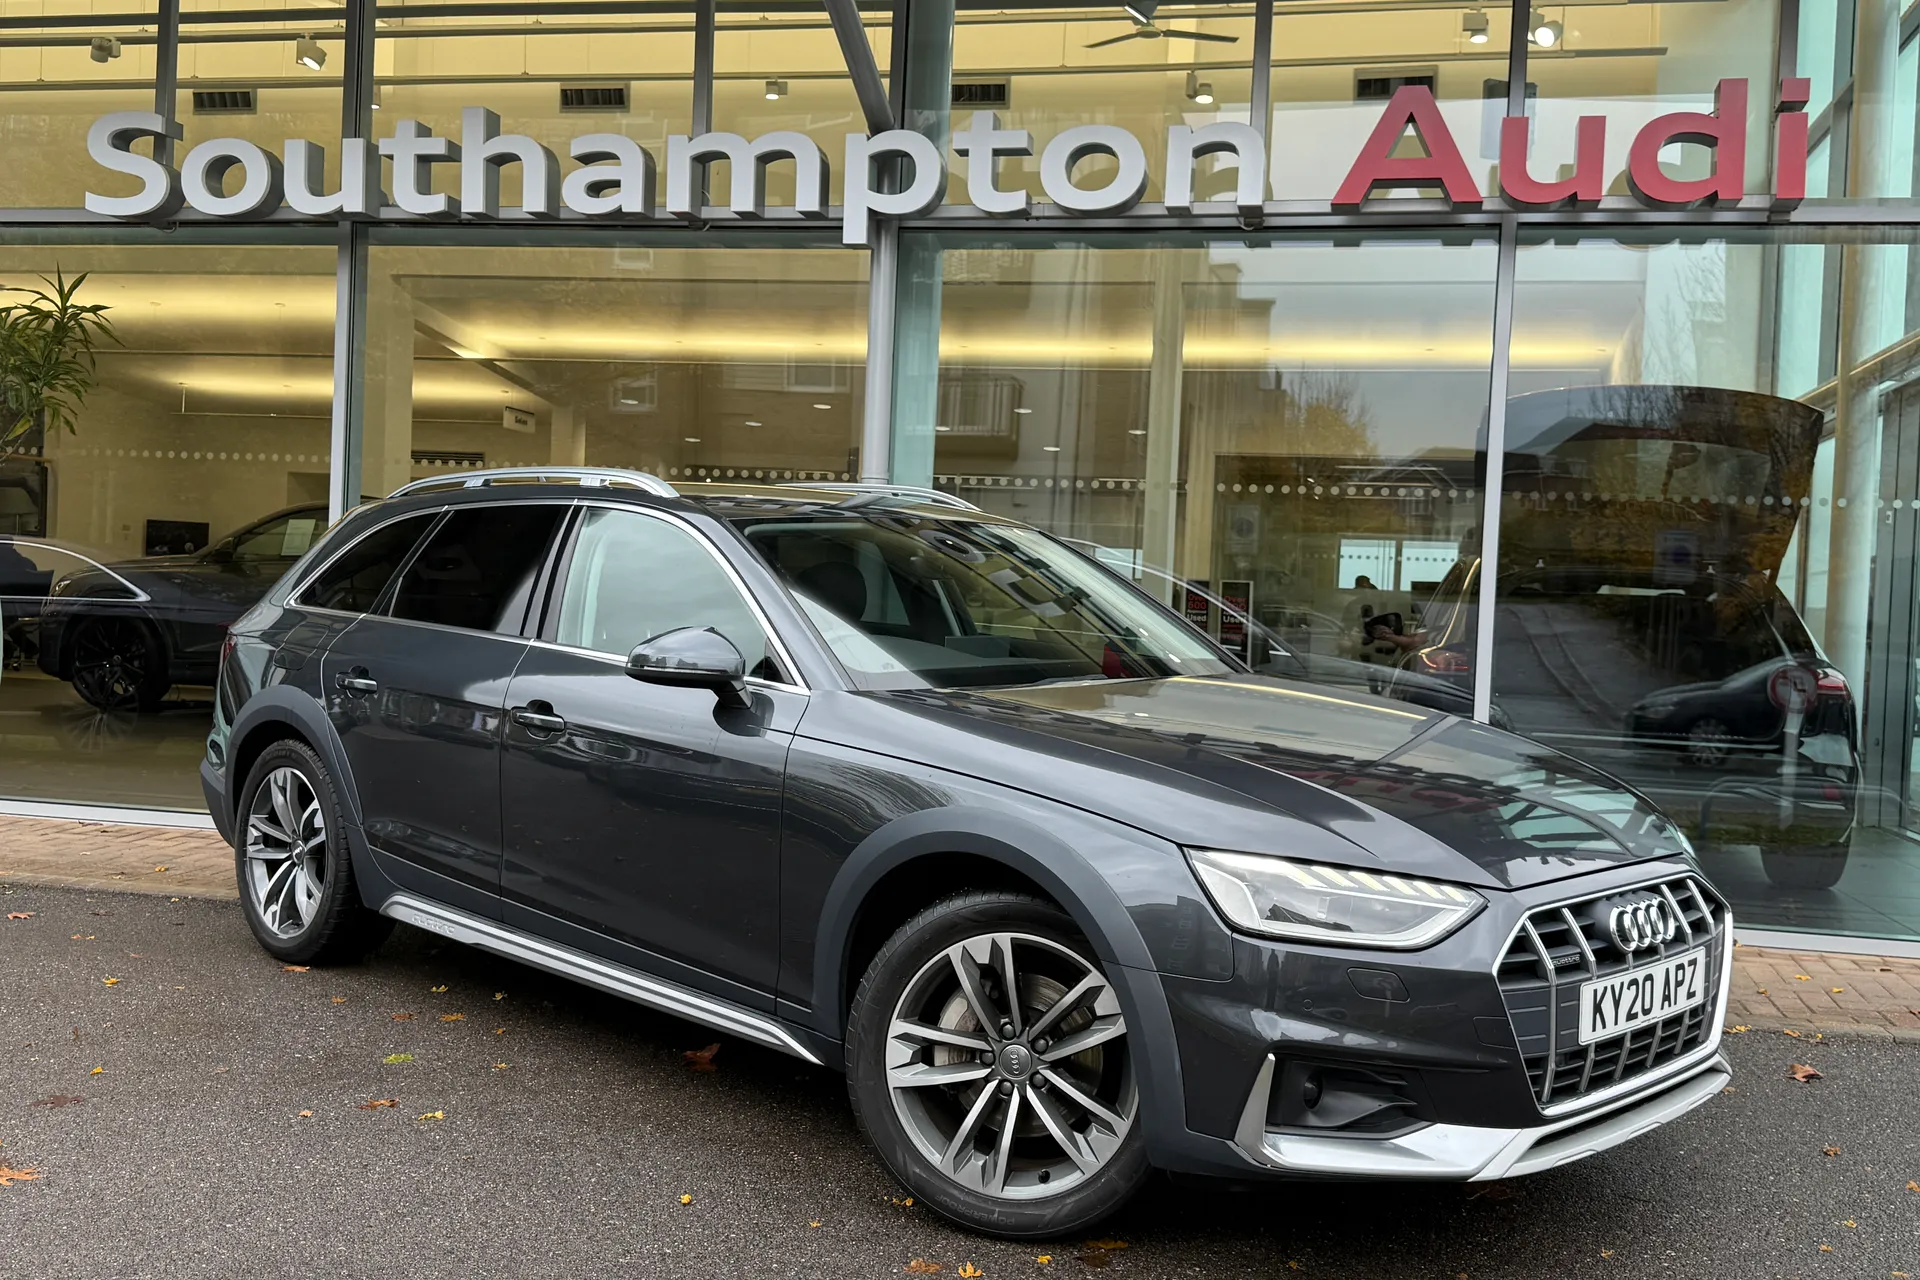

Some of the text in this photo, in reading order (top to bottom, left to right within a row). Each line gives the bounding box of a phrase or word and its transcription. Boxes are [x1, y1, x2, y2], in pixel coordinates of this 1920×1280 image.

[84, 77, 1811, 247] Southampton Audi
[1592, 957, 1698, 1033] KY20 APZ
[934, 1194, 1016, 1226] POWERPROOF
